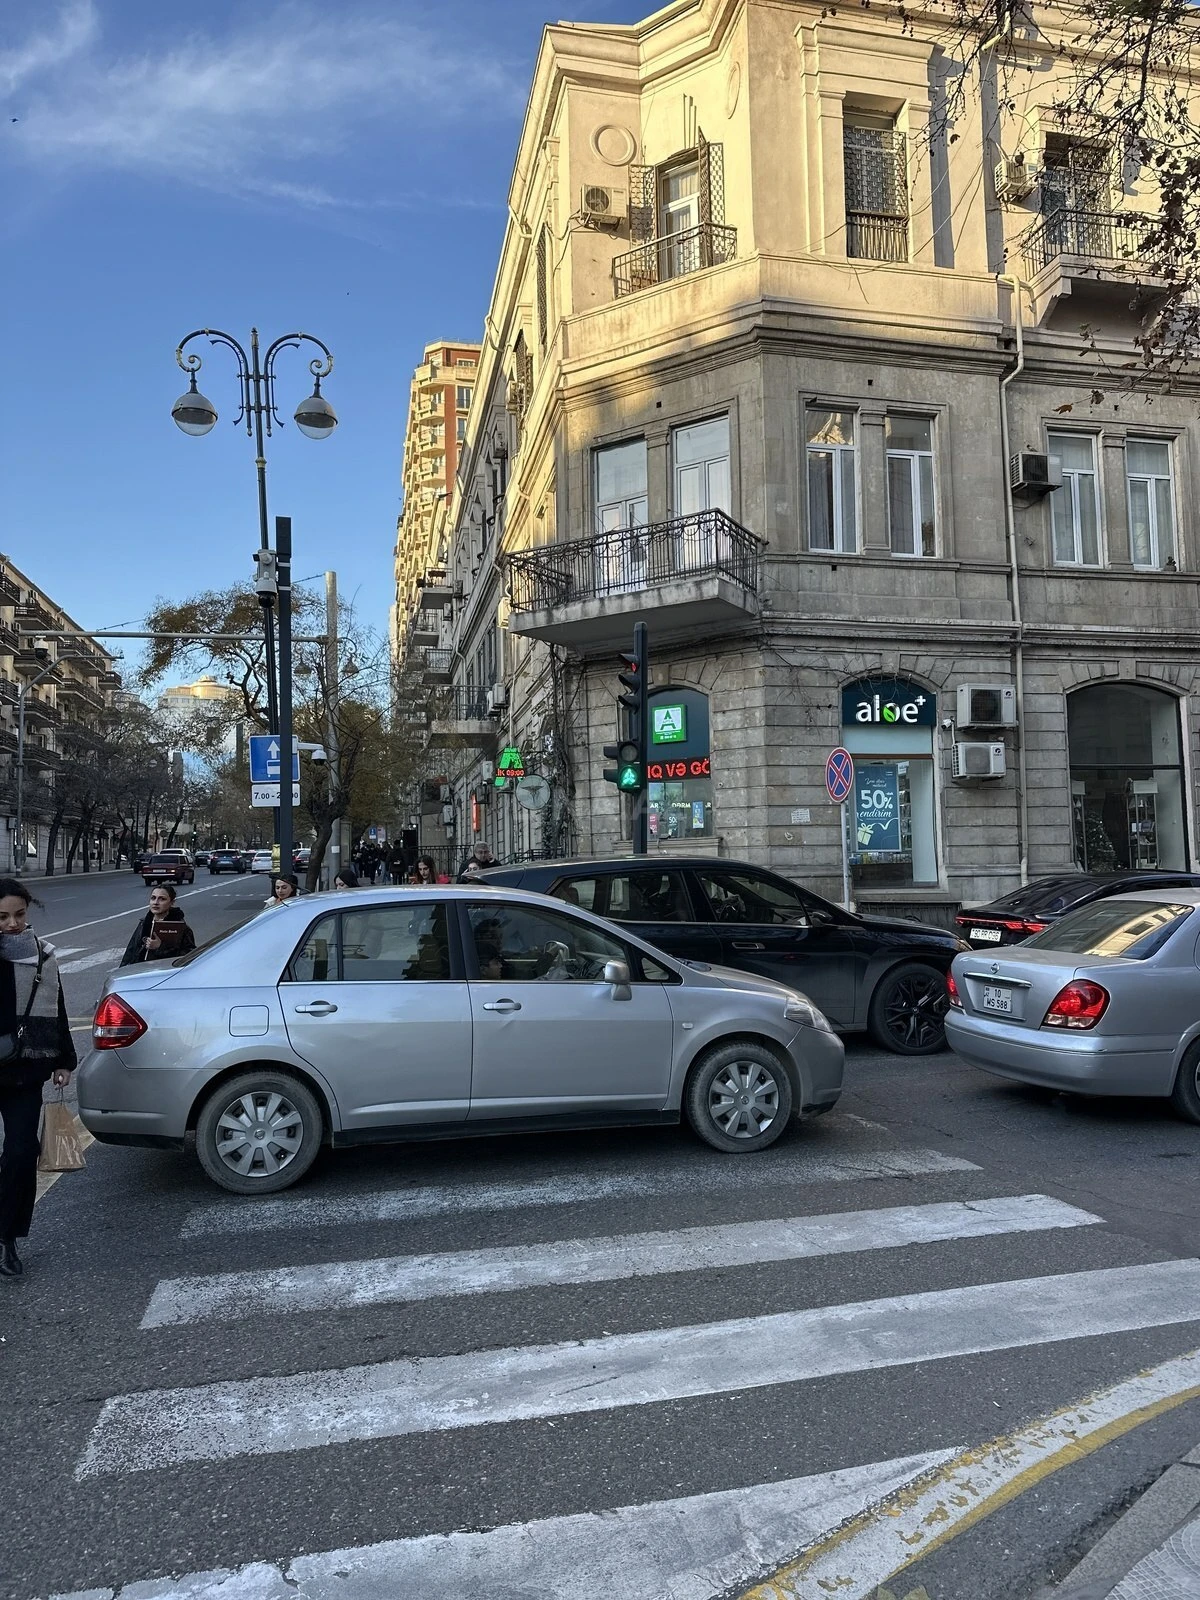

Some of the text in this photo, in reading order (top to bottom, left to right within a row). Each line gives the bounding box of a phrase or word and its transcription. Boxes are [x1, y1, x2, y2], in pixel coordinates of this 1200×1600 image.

[665, 763, 687, 778] VƏ
[861, 789, 894, 810] 50%
[860, 808, 892, 818] endirim
[994, 988, 1002, 998] 10
